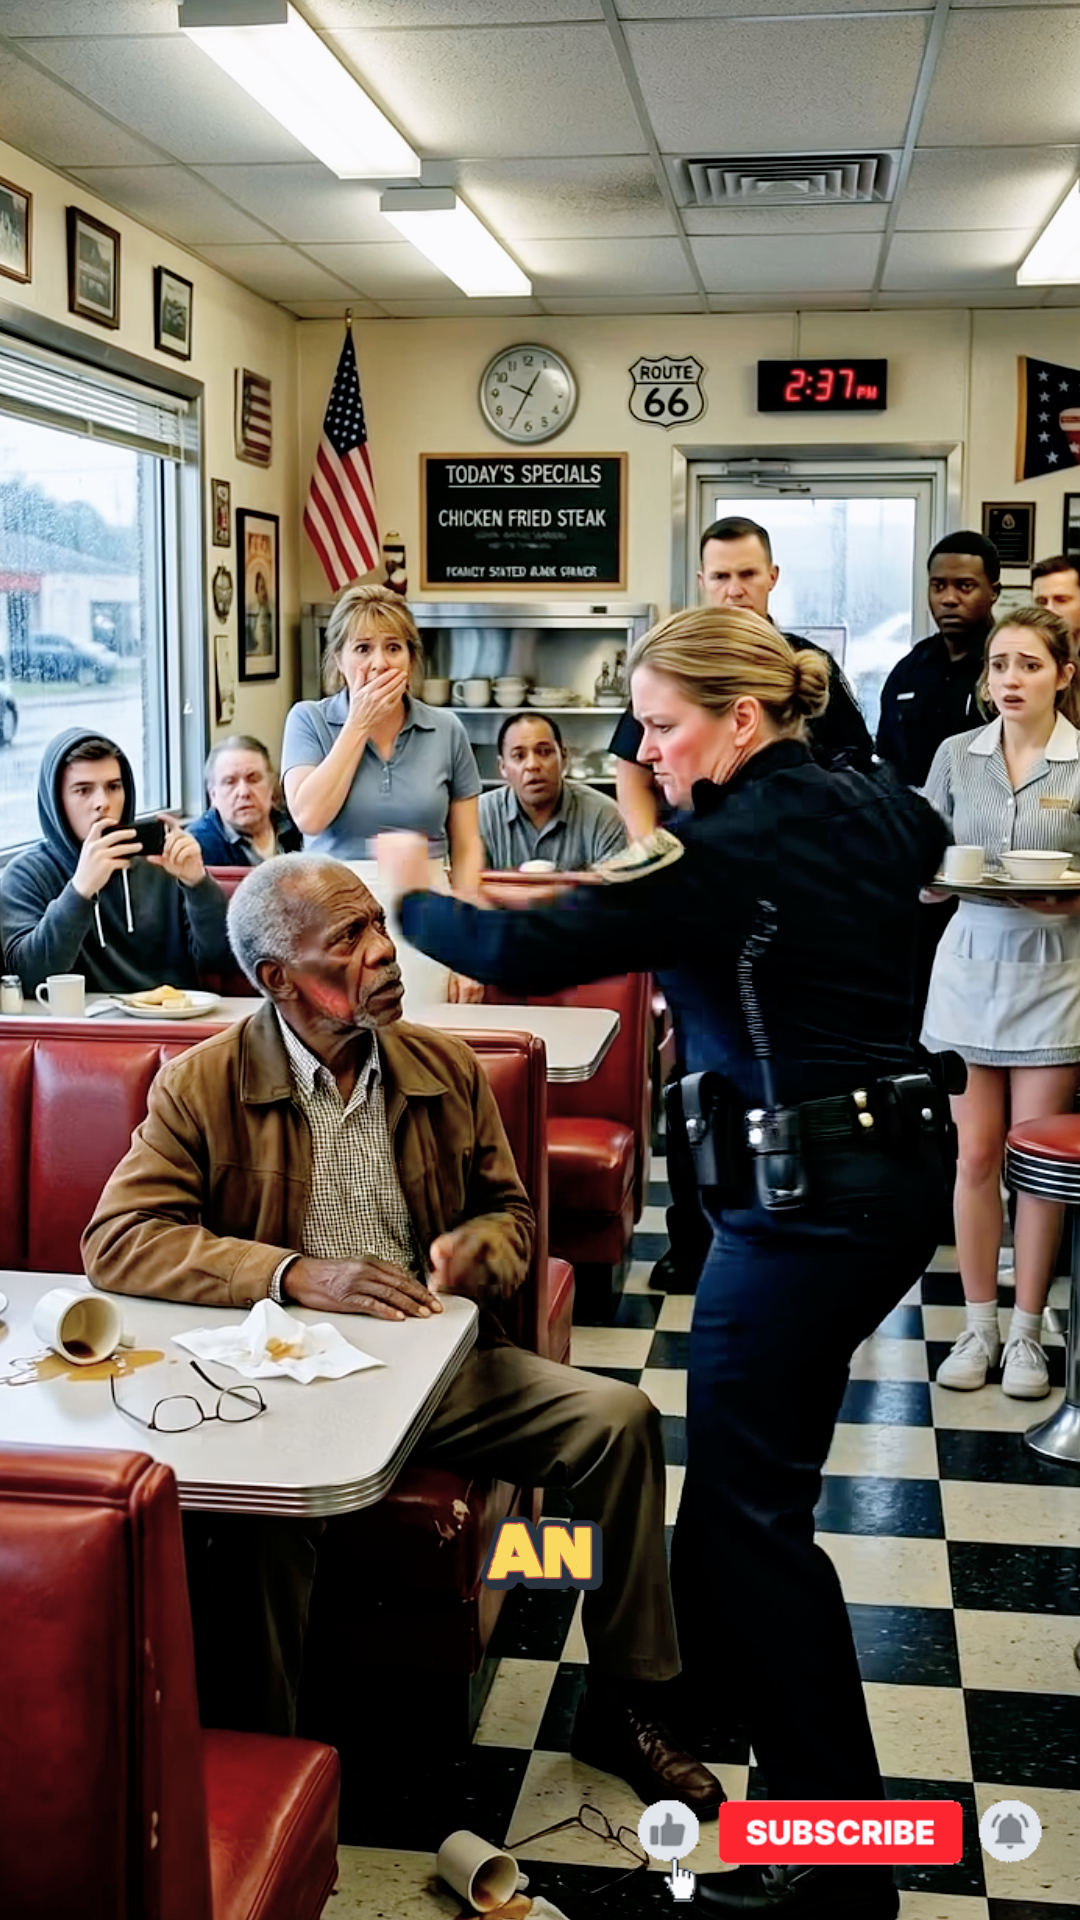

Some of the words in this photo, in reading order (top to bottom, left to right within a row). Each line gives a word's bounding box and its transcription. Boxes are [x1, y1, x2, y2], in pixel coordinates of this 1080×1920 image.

[523, 355, 534, 367] 12
[640, 365, 694, 380] ROUTE
[784, 368, 856, 402] 2:37
[857, 386, 878, 400] PM
[644, 387, 690, 418] 66
[445, 464, 515, 483] TODAY'S
[521, 464, 602, 484] SPECIALS
[438, 509, 503, 527] CHICKEN
[508, 509, 552, 527] FRIED
[557, 509, 607, 527] STEAK
